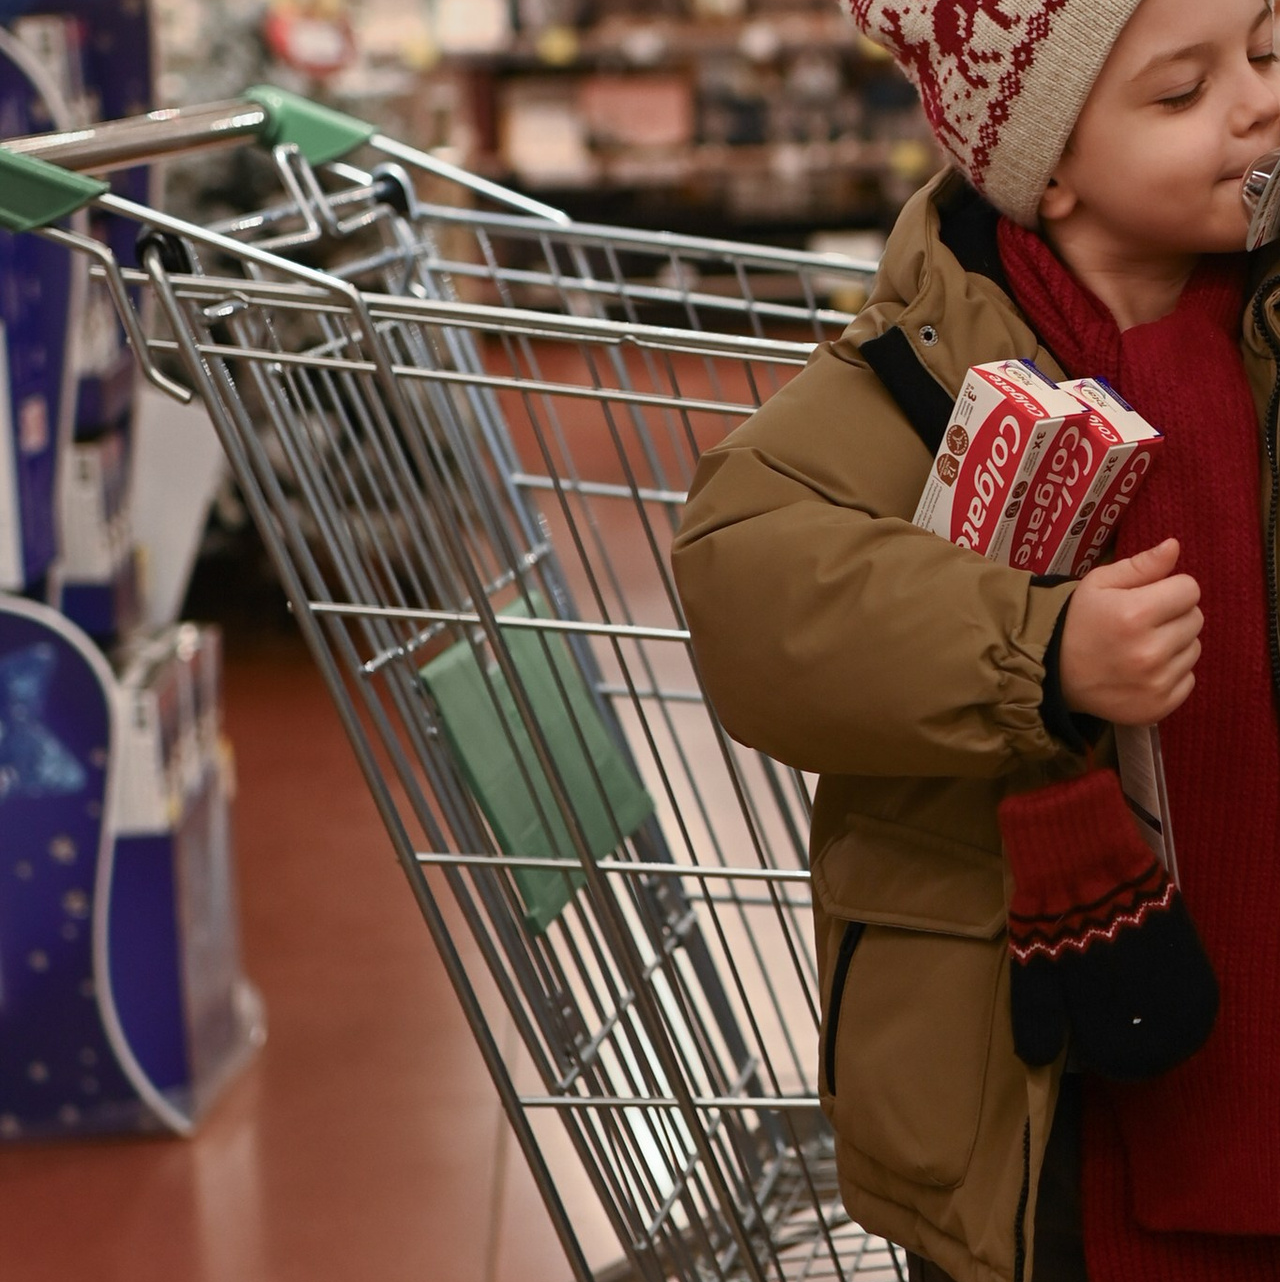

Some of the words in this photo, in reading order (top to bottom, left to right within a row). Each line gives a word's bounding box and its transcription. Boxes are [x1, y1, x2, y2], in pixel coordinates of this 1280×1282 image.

[989, 374, 1044, 418] Colgate
[1089, 414, 1118, 443] Colg
[1014, 426, 1080, 566] Colgate
[1076, 451, 1151, 577] Colgate
